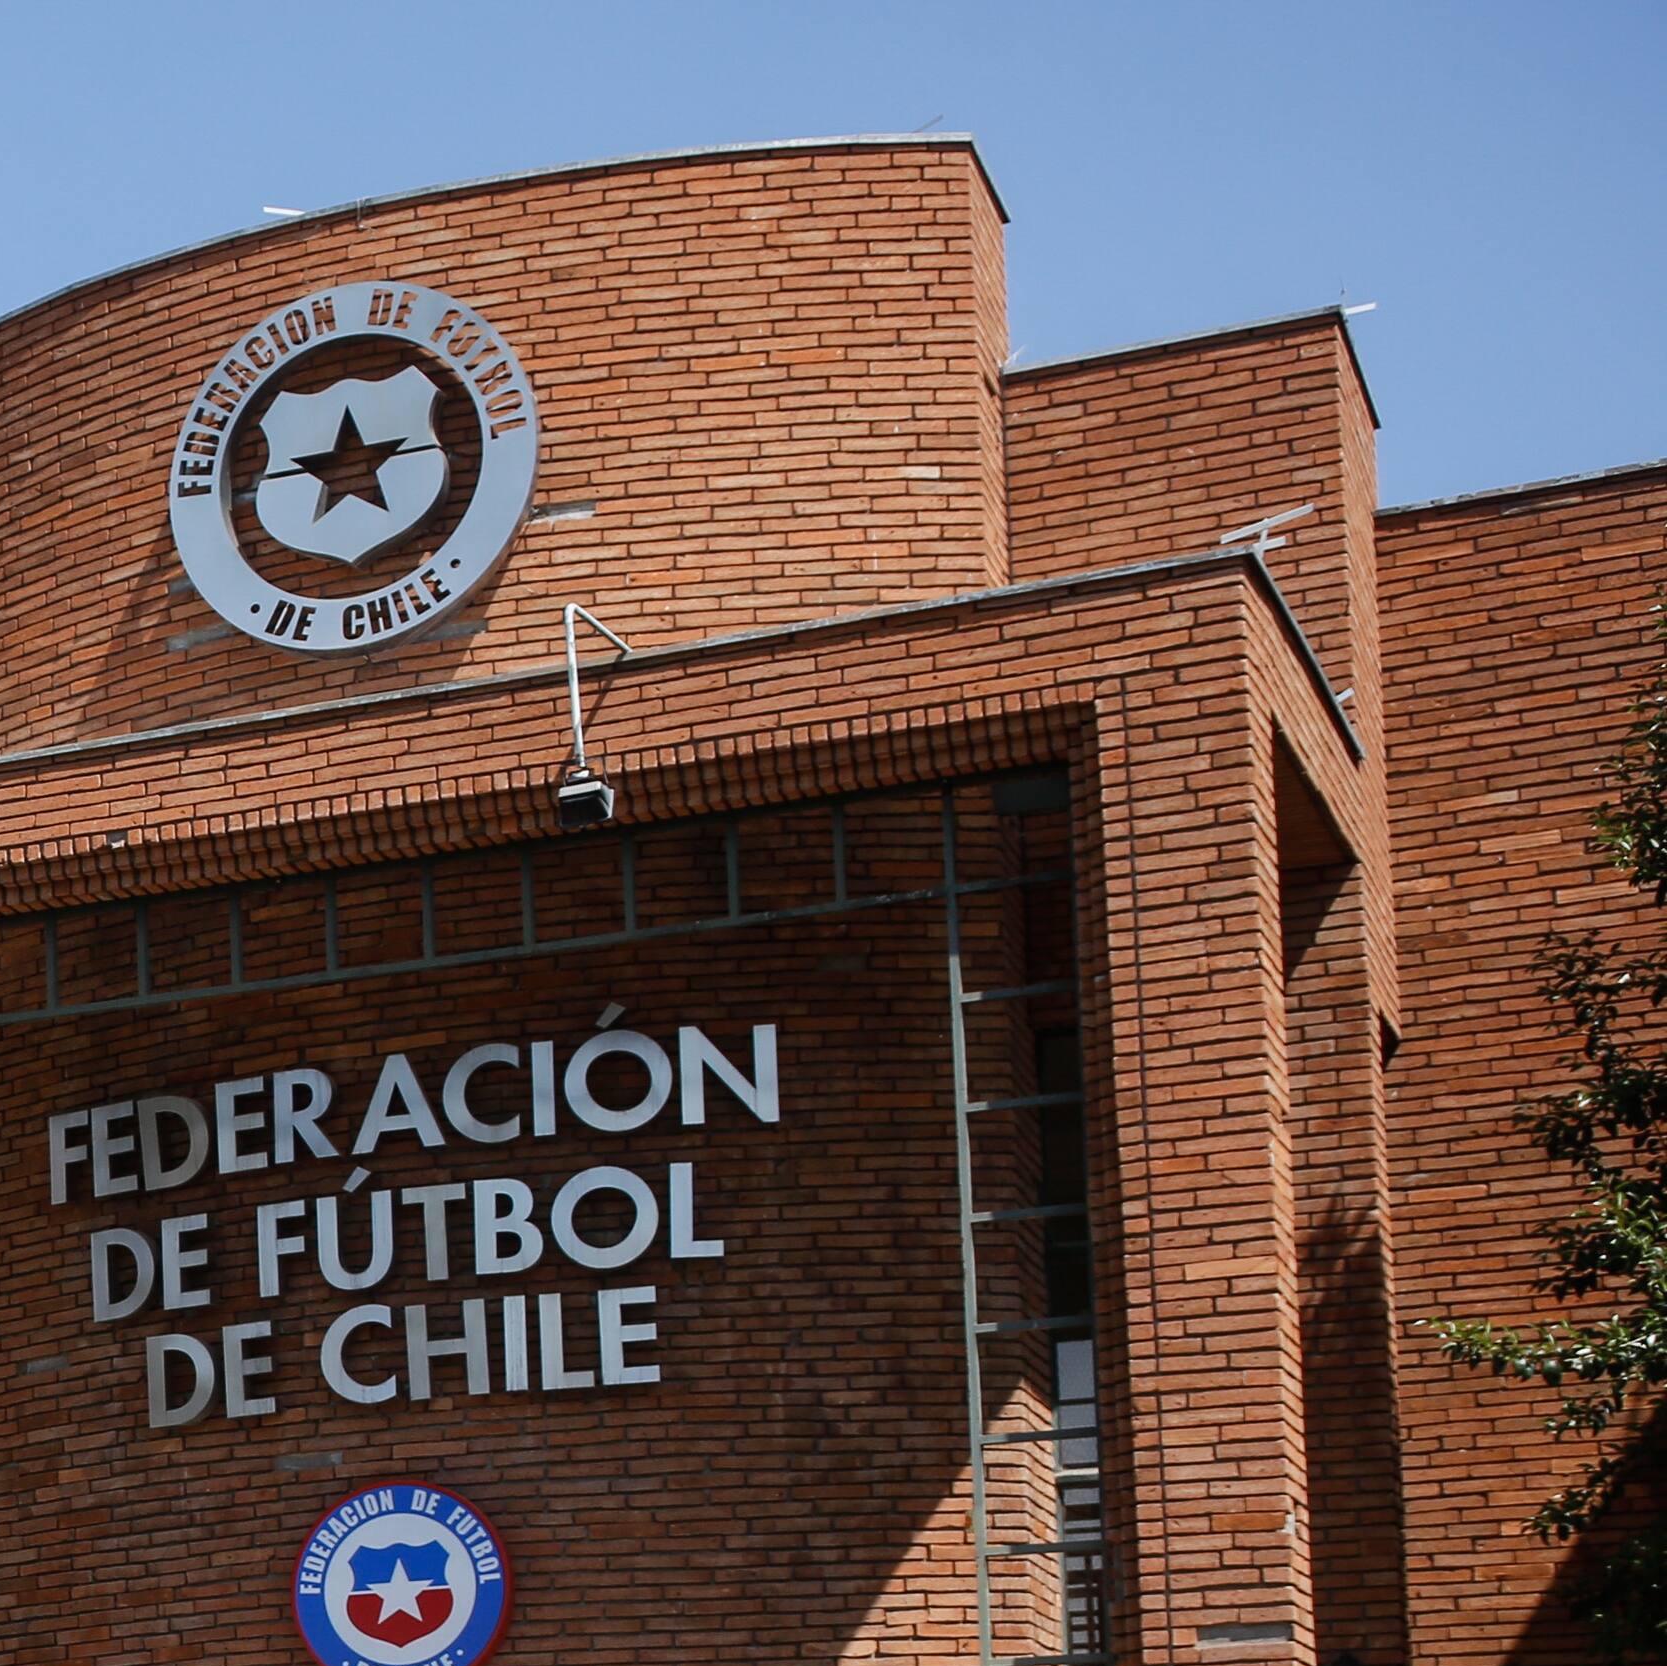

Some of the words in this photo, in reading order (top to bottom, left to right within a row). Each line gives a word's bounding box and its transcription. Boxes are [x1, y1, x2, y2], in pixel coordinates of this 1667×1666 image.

[178, 296, 337, 499] FEDERACION
[367, 289, 418, 329] DE
[430, 309, 528, 441] FUTBOL
[264, 601, 317, 641] DE
[342, 568, 452, 641] CHILE
[48, 1002, 780, 1205] FEDERACIÓN
[90, 1213, 211, 1323] DE
[256, 1161, 725, 1298] FÚTBOL
[146, 1320, 277, 1429] DE
[320, 1285, 661, 1404] CHILE
[299, 1489, 395, 1595] FEDERACION
[410, 1489, 441, 1515] DE
[446, 1506, 501, 1584] FUTBOL
